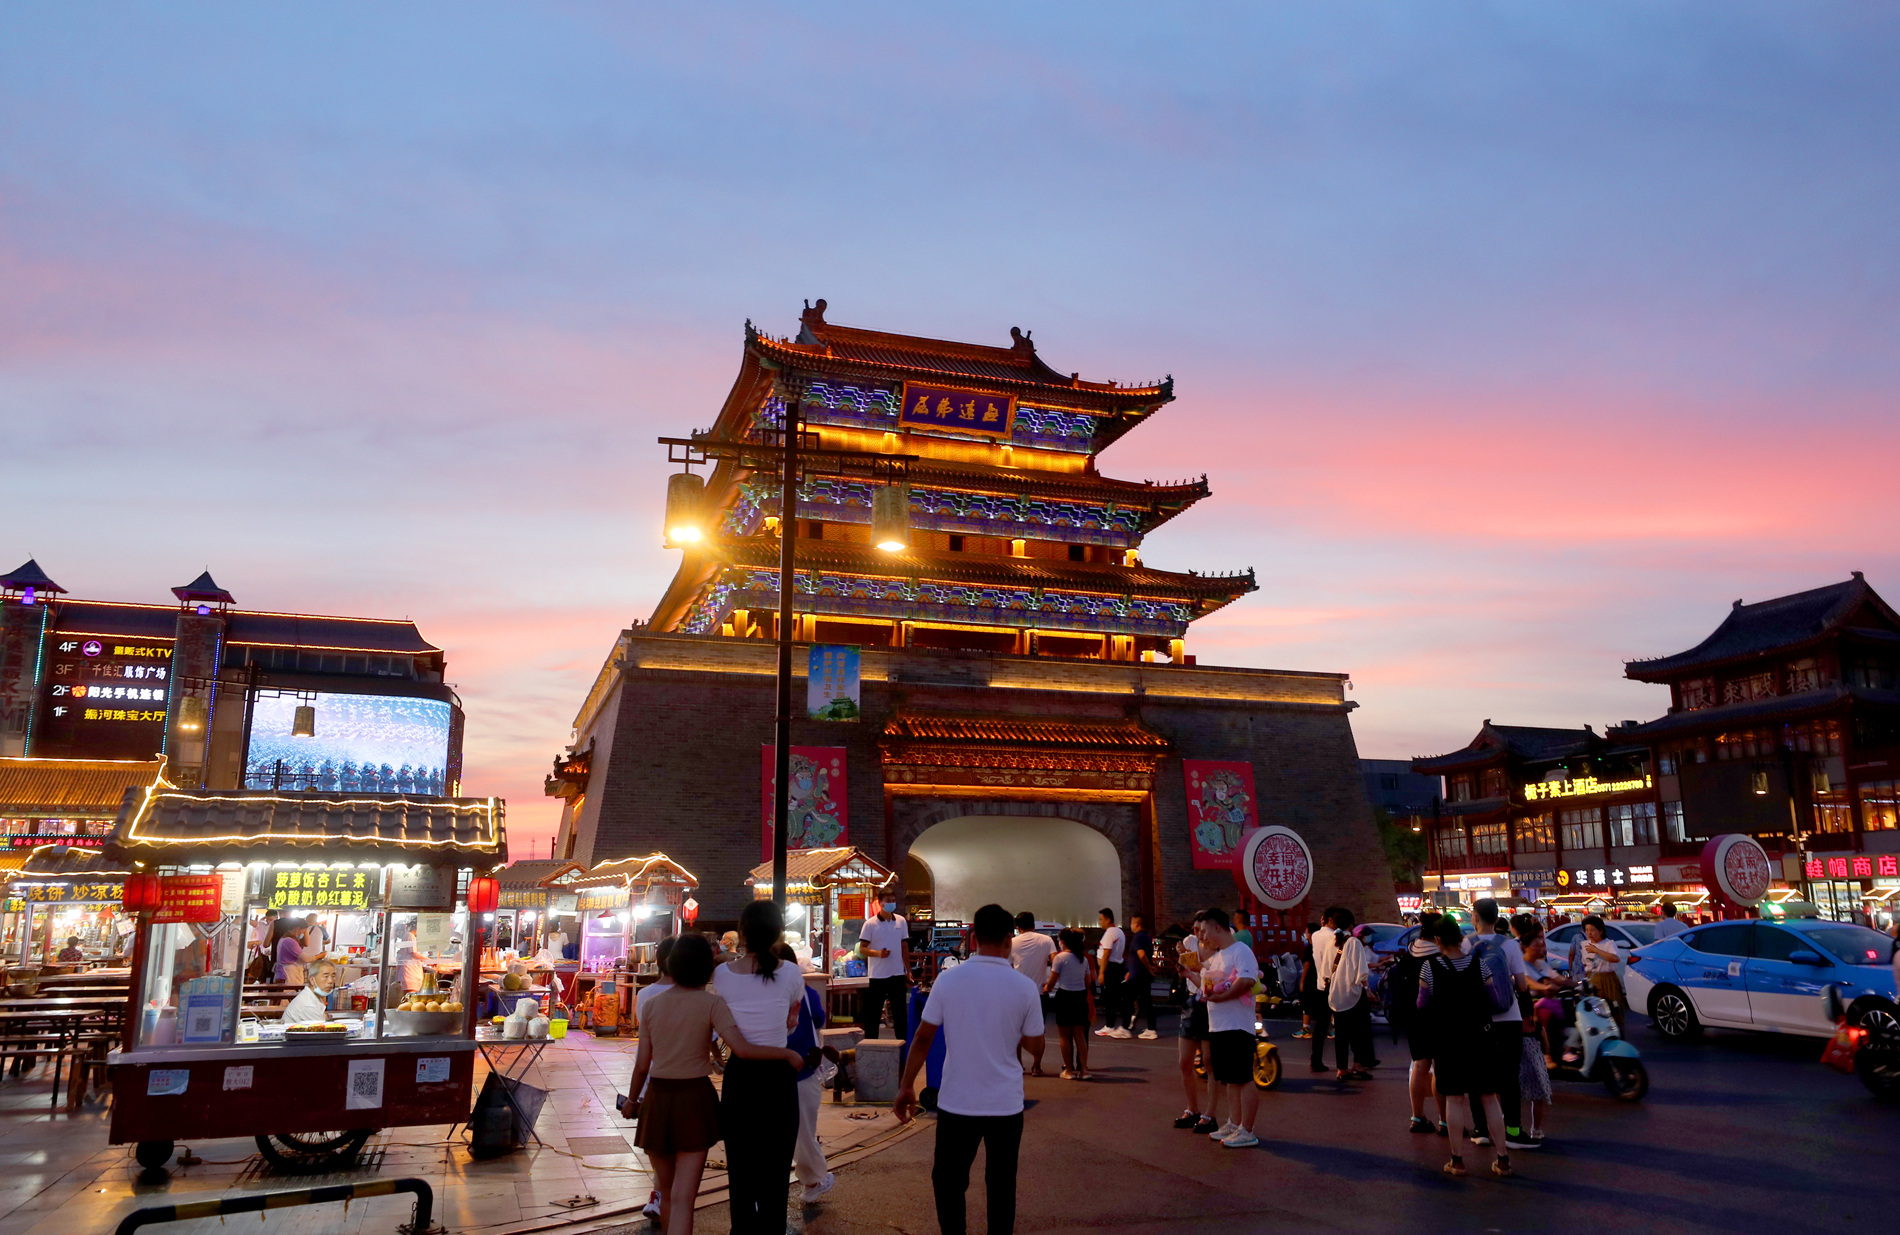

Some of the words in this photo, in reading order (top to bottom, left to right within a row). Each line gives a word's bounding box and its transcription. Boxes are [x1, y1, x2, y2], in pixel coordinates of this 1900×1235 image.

[59, 641, 78, 652] 4F
[113, 646, 172, 659] 量贩式KTV
[55, 664, 74, 675] 3F
[52, 685, 71, 696] 2F
[88, 686, 164, 701] 阳光手机连锁
[53, 706, 68, 717] 1F
[84, 708, 166, 722] 振河珠宝大厅
[1268, 852, 1294, 866] 幸福
[1806, 856, 1898, 878] 鞋帽商店
[275, 872, 315, 888] 菠萝饭
[317, 872, 366, 888] 杏仁茶
[1268, 868, 1295, 884] 开封
[1575, 868, 1624, 885] 华莱士
[28, 885, 66, 901] 烧饼
[274, 890, 314, 906] 炒酸奶
[316, 890, 364, 906] 炒红薯泥
